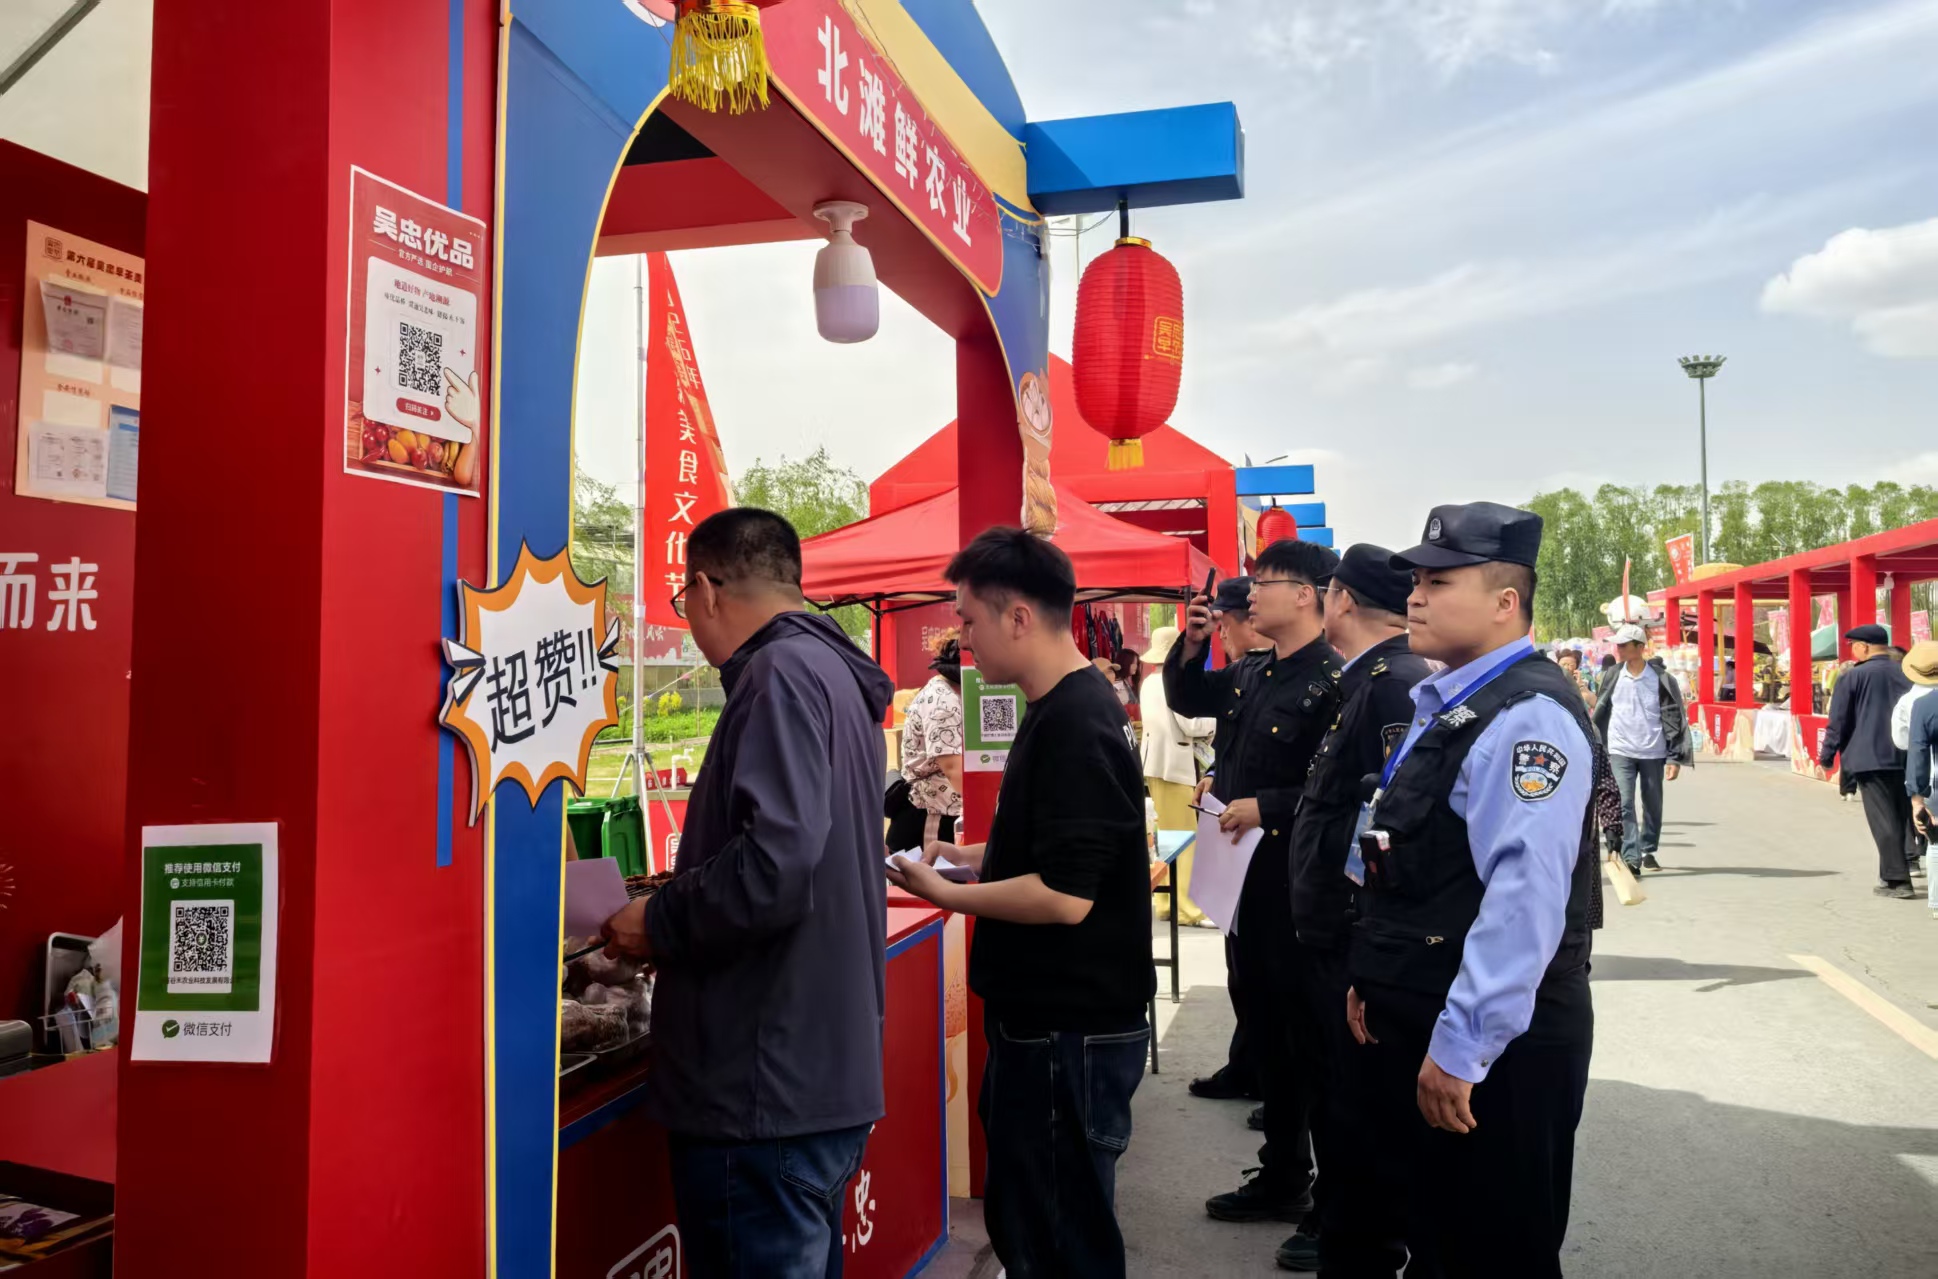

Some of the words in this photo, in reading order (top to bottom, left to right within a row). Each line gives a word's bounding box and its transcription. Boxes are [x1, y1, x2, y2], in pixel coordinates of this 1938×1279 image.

[817, 15, 972, 247] 北滩鲜农业
[373, 205, 474, 270] 吴忠优品
[1516, 744, 1567, 767] 中华人民共和国
[164, 861, 241, 874] 推荐使用微信支付
[183, 1022, 233, 1037] 微信支付
